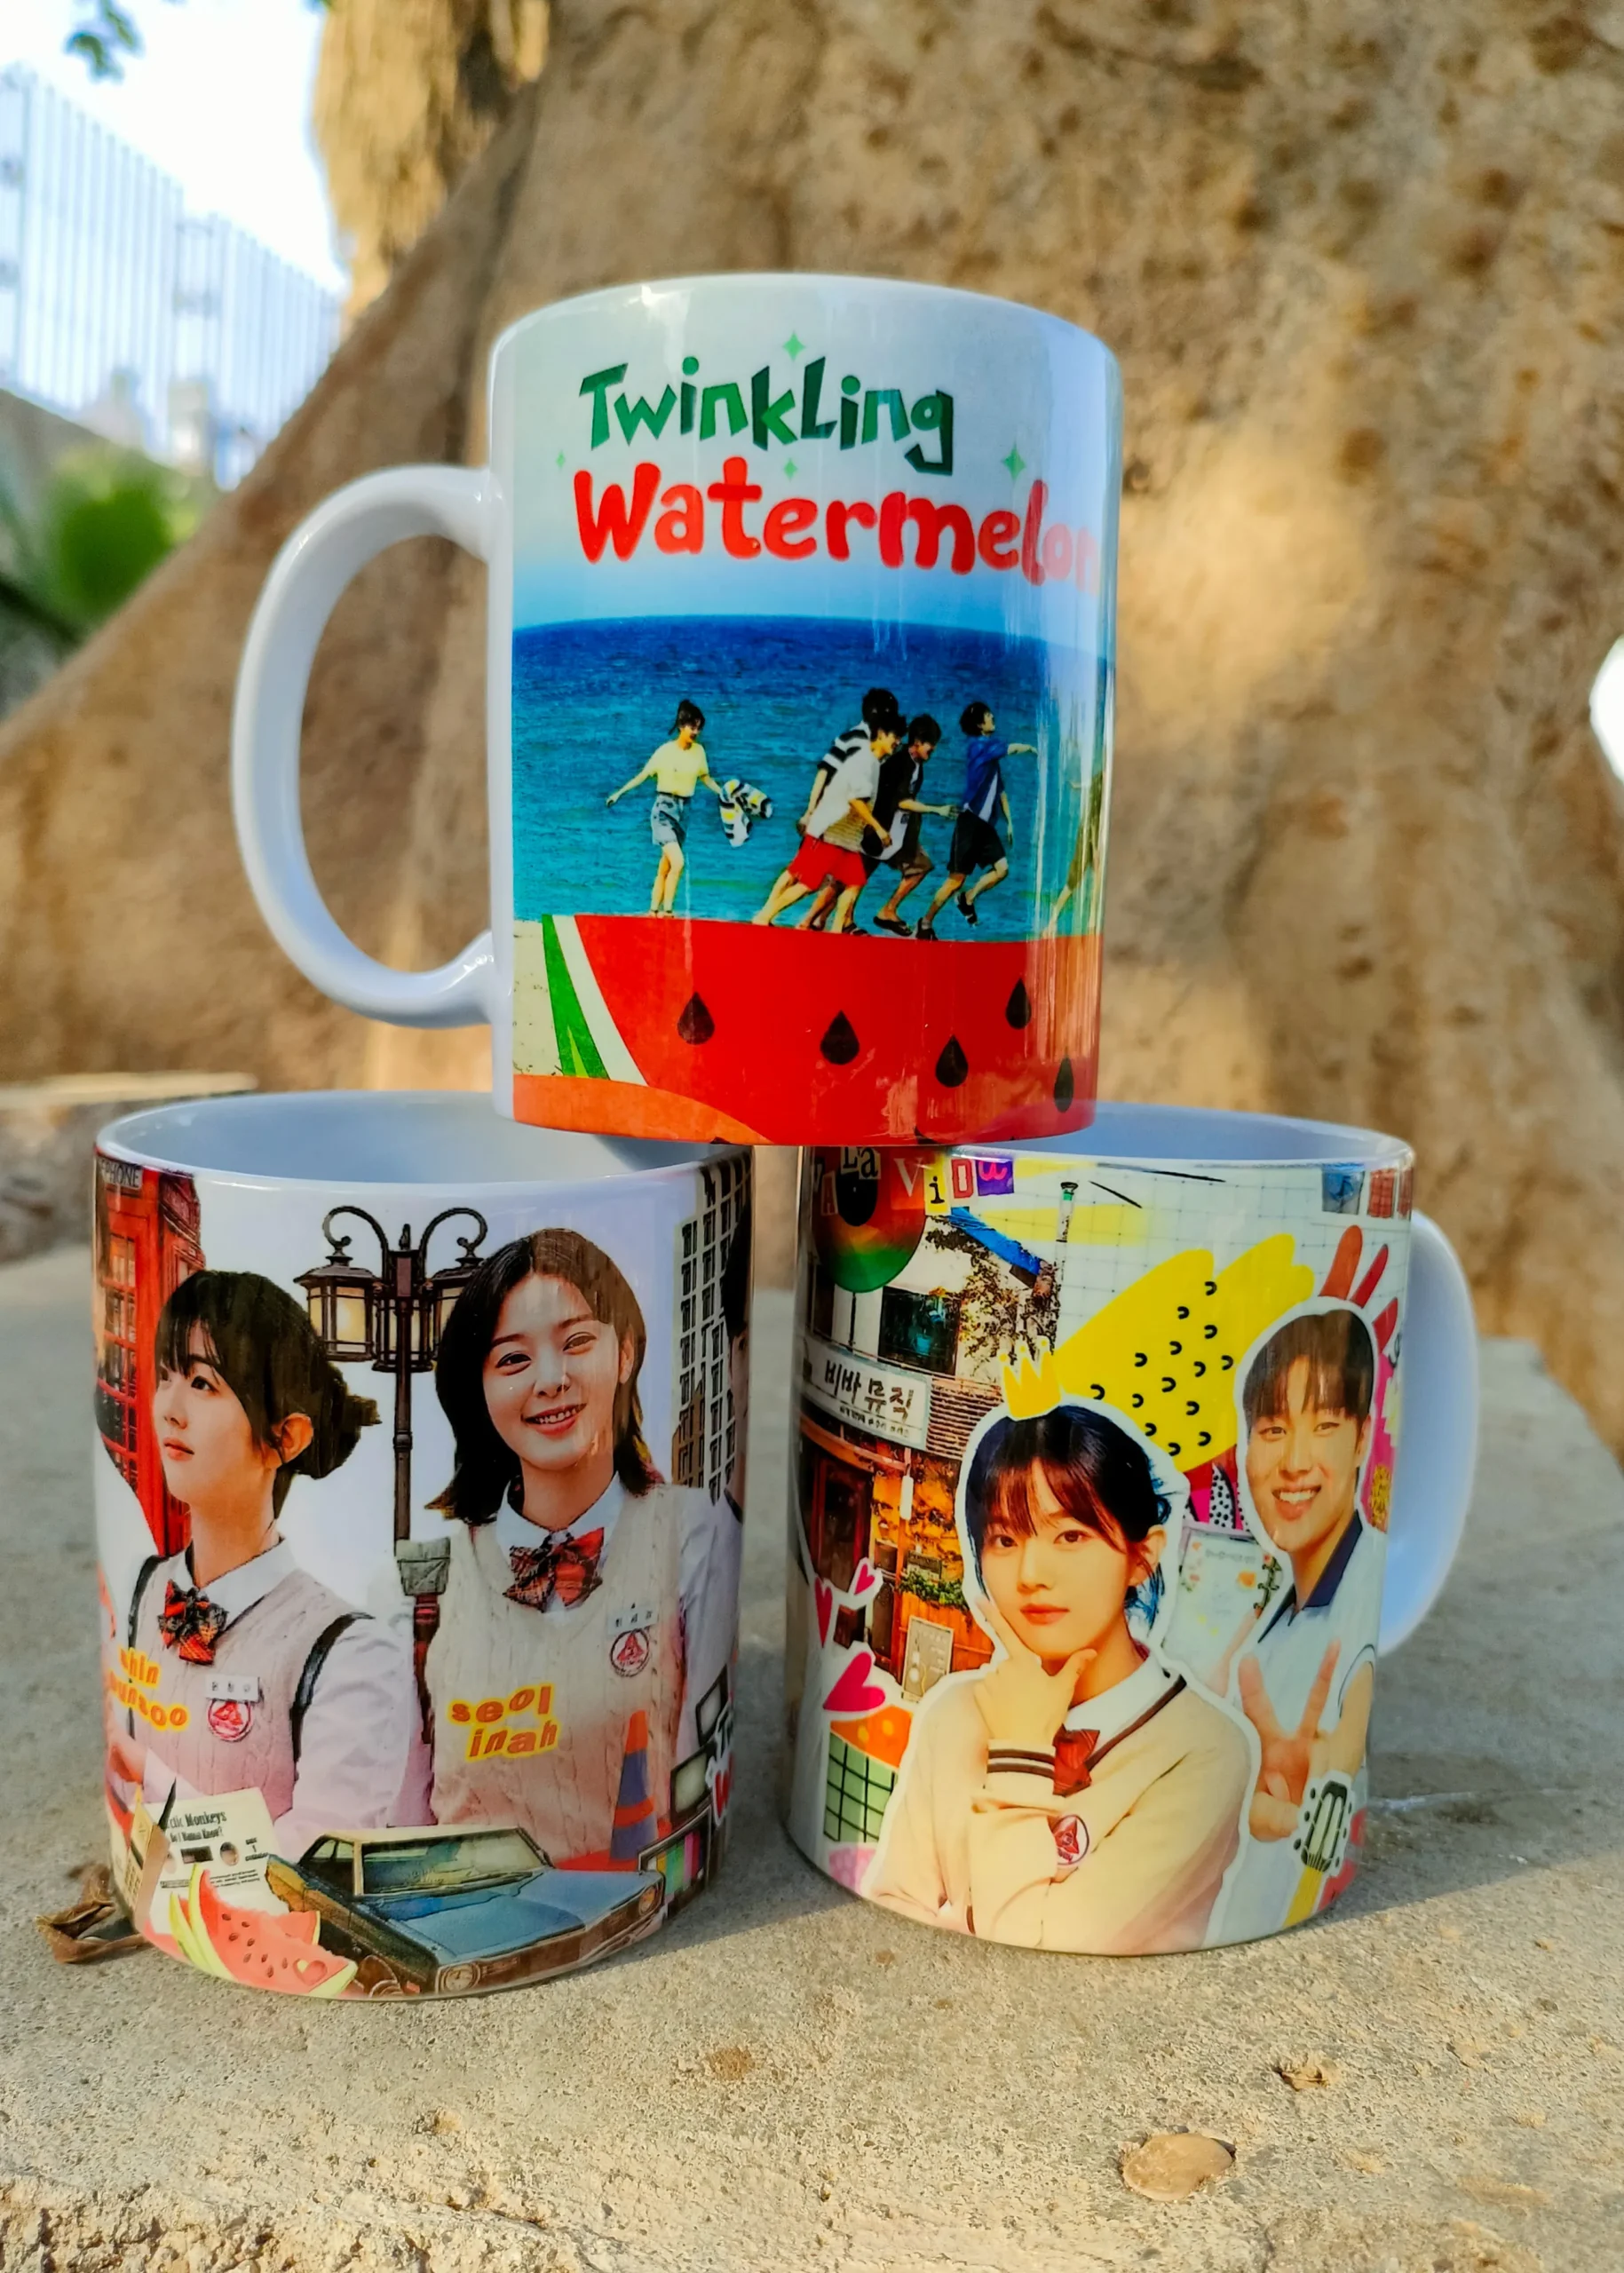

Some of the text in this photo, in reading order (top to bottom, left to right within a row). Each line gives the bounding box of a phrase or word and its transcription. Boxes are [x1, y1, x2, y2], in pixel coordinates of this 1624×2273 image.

[574, 455, 1100, 597] Watermelon
[824, 1359, 862, 1405] 비바
[864, 1377, 915, 1424] 뮤직
[450, 1684, 552, 1723] seol
[468, 1719, 558, 1758] inah
[184, 1811, 227, 1827] Monkeys
